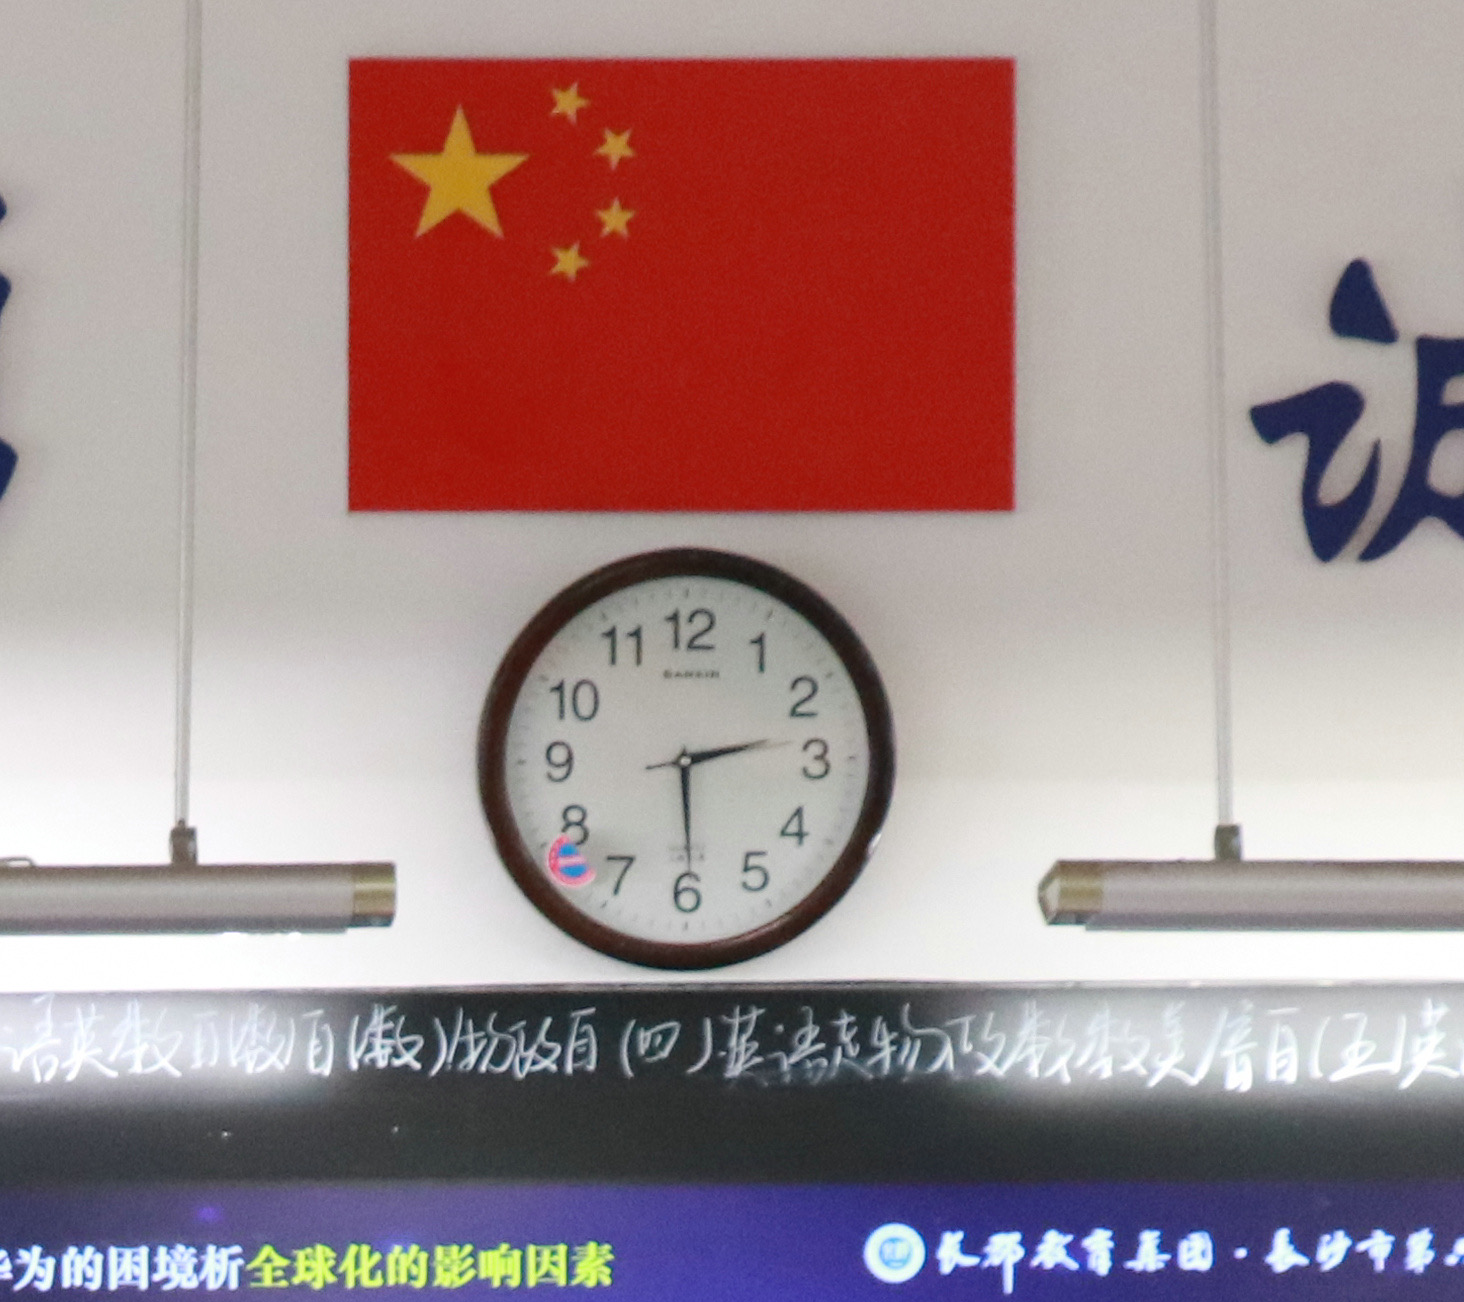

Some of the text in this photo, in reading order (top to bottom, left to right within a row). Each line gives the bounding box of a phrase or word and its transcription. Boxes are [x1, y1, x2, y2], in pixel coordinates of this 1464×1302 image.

[602, 625, 643, 666] 11
[665, 608, 716, 651] 12
[749, 633, 767, 673] 1
[550, 679, 599, 721] 10
[789, 676, 818, 718] 2
[545, 741, 573, 782] 9
[801, 738, 830, 780] 3
[562, 805, 589, 846] 8
[781, 806, 810, 845] 4
[607, 856, 636, 895] 7
[673, 872, 701, 912] 6
[742, 851, 768, 892] 5
